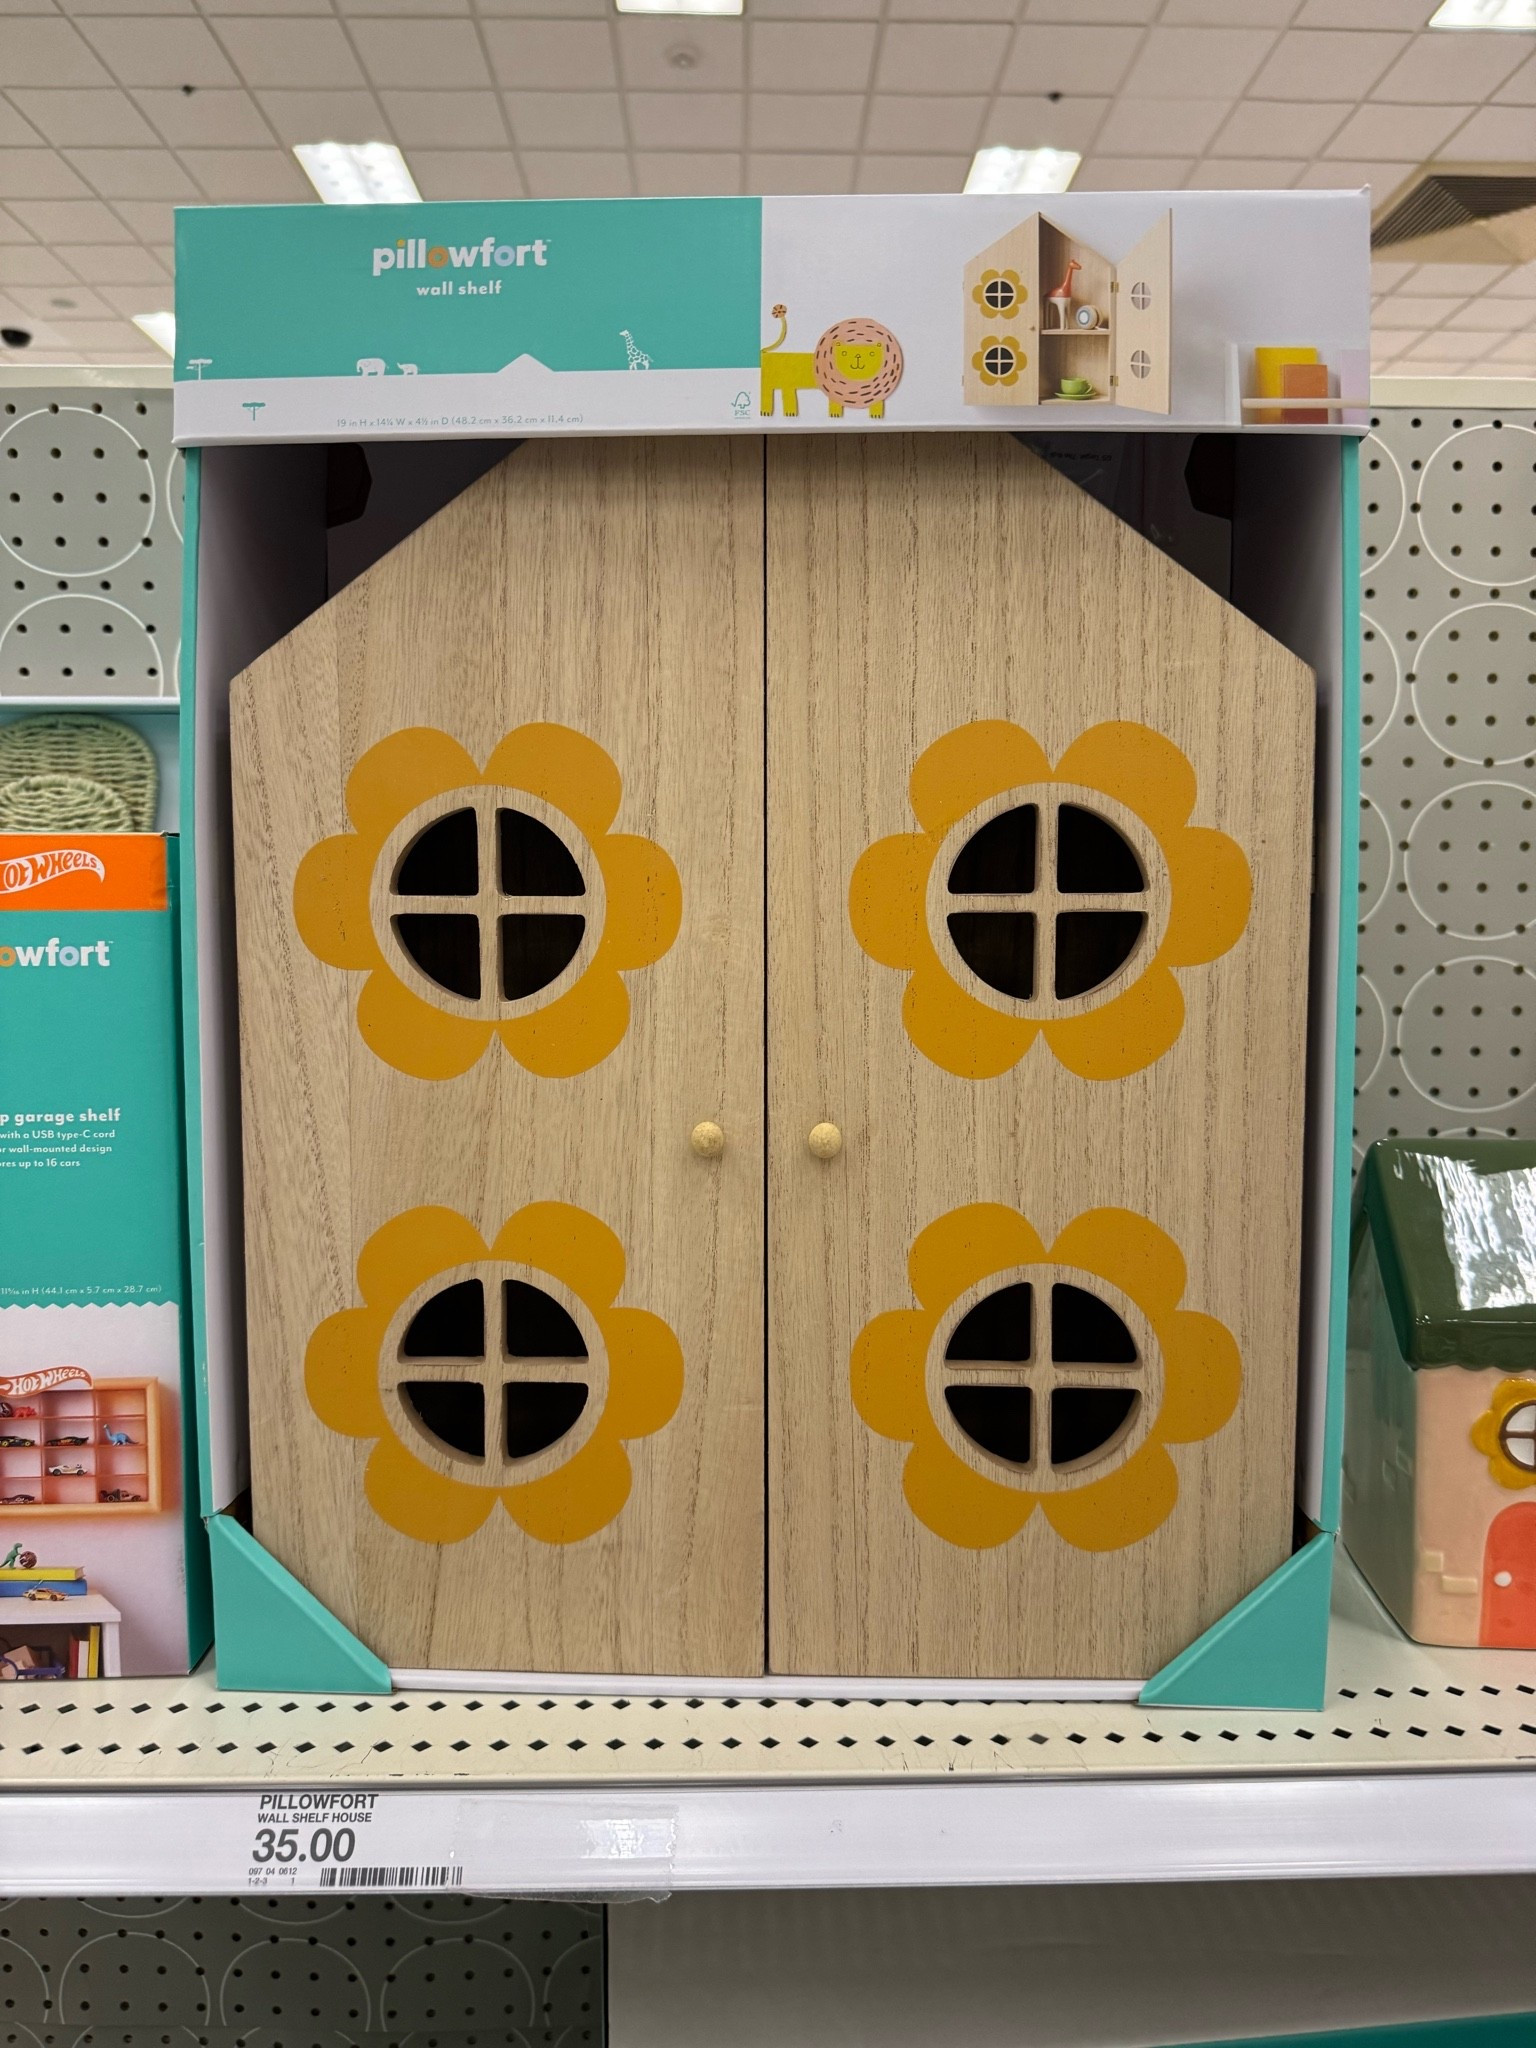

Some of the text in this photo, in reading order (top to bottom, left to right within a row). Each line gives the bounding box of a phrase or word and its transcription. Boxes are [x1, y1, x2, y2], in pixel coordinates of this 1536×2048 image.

[373, 237, 547, 276] pillowfort
[416, 280, 502, 296] wall shelf
[337, 419, 346, 427] 19
[360, 419, 367, 427] H
[397, 418, 406, 426] W
[441, 417, 449, 425] D
[452, 416, 476, 426] (48.2
[502, 415, 522, 424] 36.2
[567, 414, 584, 424] cm)
[0, 858, 31, 889] OT
[15, 1113, 75, 1126] garage
[79, 1108, 121, 1122] shelf
[0, 1131, 21, 1139] with
[32, 1130, 55, 1139] USB
[57, 1130, 91, 1141] type-C
[93, 1130, 116, 1138] cord
[9, 1144, 77, 1153] wall-mounted
[79, 1144, 112, 1154] design
[18, 1161, 31, 1170] up
[46, 1158, 57, 1167] 16
[41, 1286, 63, 1295] (44.1
[87, 1286, 100, 1294] 5.7
[124, 1285, 144, 1293] 28.7
[146, 1285, 162, 1294] cm)
[259, 1794, 379, 1810] PILLOWFORT
[257, 1812, 372, 1823] WALL SHELF HOUSE
[252, 1828, 356, 1862] 35.00
[249, 1866, 298, 1875] 097 04 0612
[291, 1877, 295, 1886] 1
